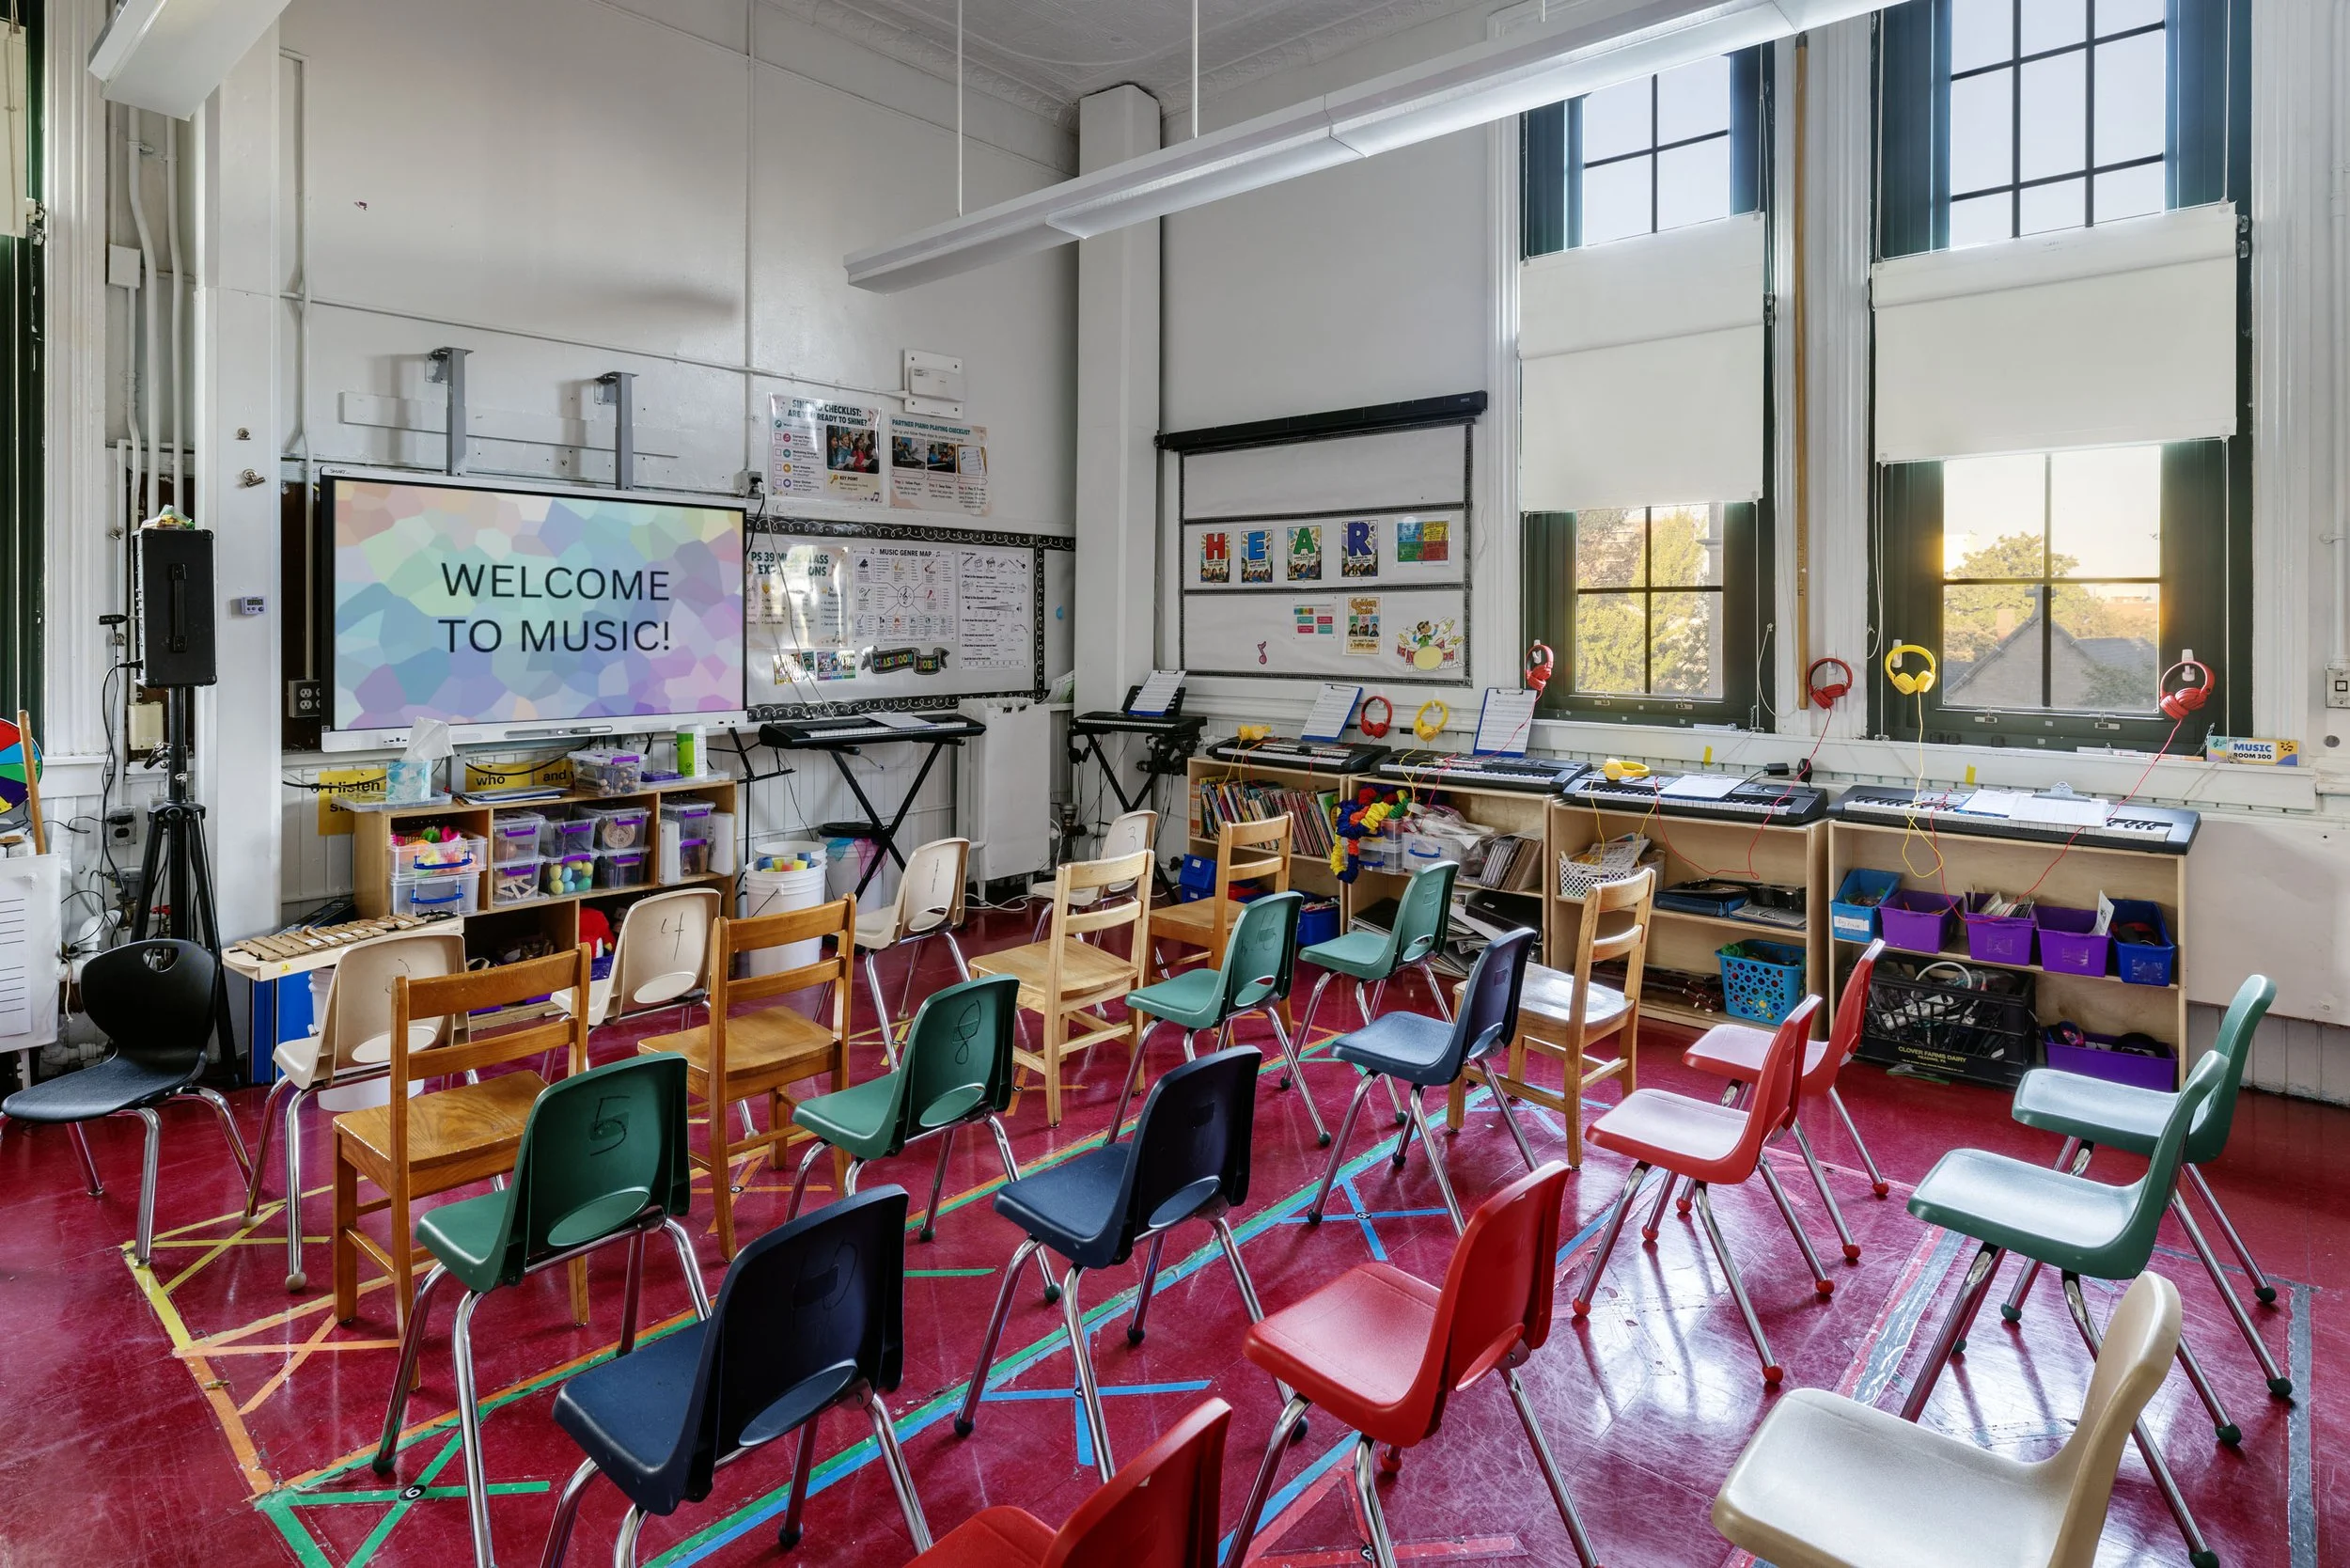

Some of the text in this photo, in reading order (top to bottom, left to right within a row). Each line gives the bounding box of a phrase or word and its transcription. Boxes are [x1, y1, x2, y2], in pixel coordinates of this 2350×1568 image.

[788, 409, 801, 417] ARE
[817, 414, 838, 423] READY
[824, 404, 862, 416] CHECKLIST:
[892, 419, 914, 428] PARTNER
[930, 424, 948, 432] PLAYING
[949, 427, 971, 435] CHECKLIST
[1206, 533, 1225, 560] H
[1248, 531, 1265, 560] E
[1293, 527, 1315, 555] A
[1348, 522, 1372, 557] R
[752, 552, 762, 561] PS
[764, 552, 775, 562] 39
[442, 562, 670, 601] WELCOME
[438, 619, 669, 653] TO MUSIC!
[874, 652, 913, 667] CLASSROOM
[917, 660, 937, 669] JOBS
[2233, 743, 2272, 752] MUSIC
[477, 770, 567, 786] who and
[338, 781, 380, 793] listen
[661, 911, 684, 962] 4
[955, 999, 981, 1065] 8
[1898, 1046, 1923, 1055] CLOVER
[1924, 1050, 1947, 1059] FARMS
[1947, 1055, 1967, 1063] DAIRY
[590, 1096, 631, 1156] 5
